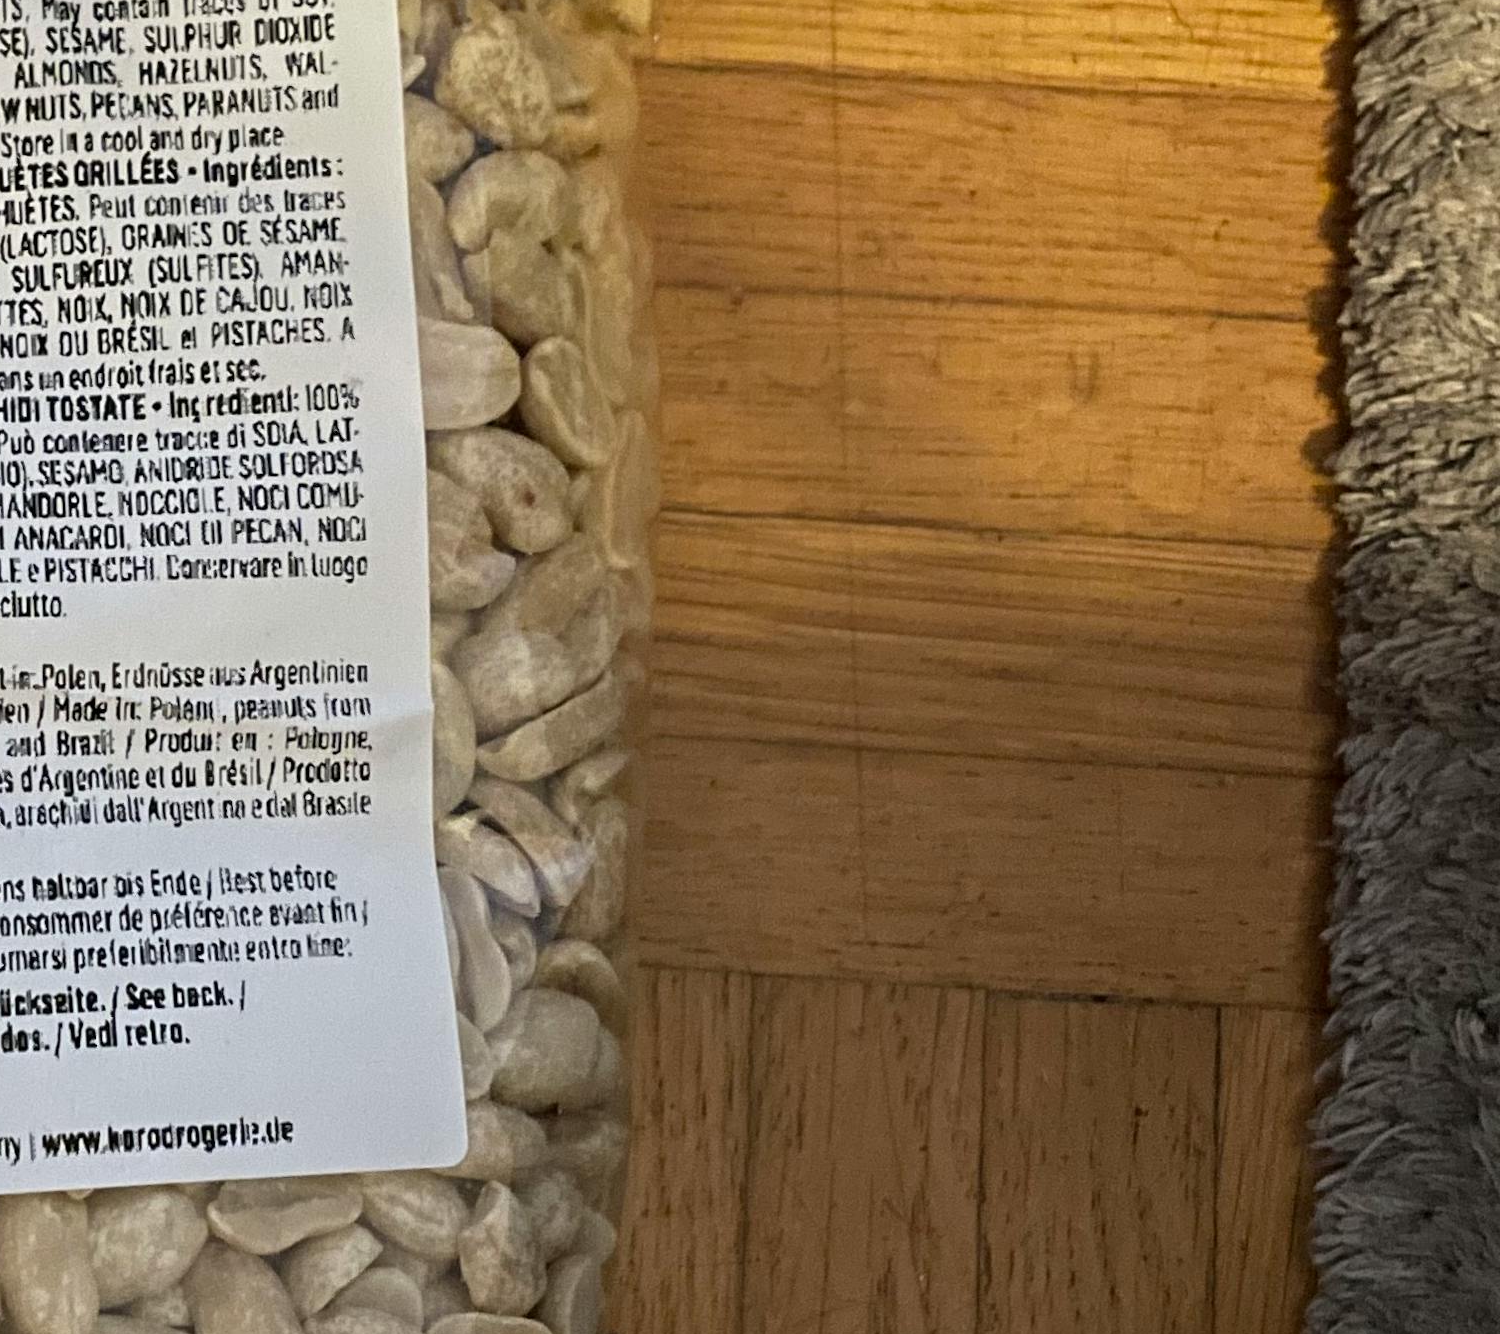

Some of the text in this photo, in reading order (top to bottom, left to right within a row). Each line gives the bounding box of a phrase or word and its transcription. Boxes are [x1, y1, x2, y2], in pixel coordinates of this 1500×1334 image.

[253, 12, 336, 48] DIOXIDE
[301, 82, 340, 114] and
[190, 123, 223, 156] dry
[68, 361, 145, 392] endroit
[46, 392, 147, 423] TOSTATE
[52, 695, 109, 723] Made
[149, 868, 202, 898] Ende
[124, 981, 167, 1011] See
[171, 979, 235, 1009] back.
